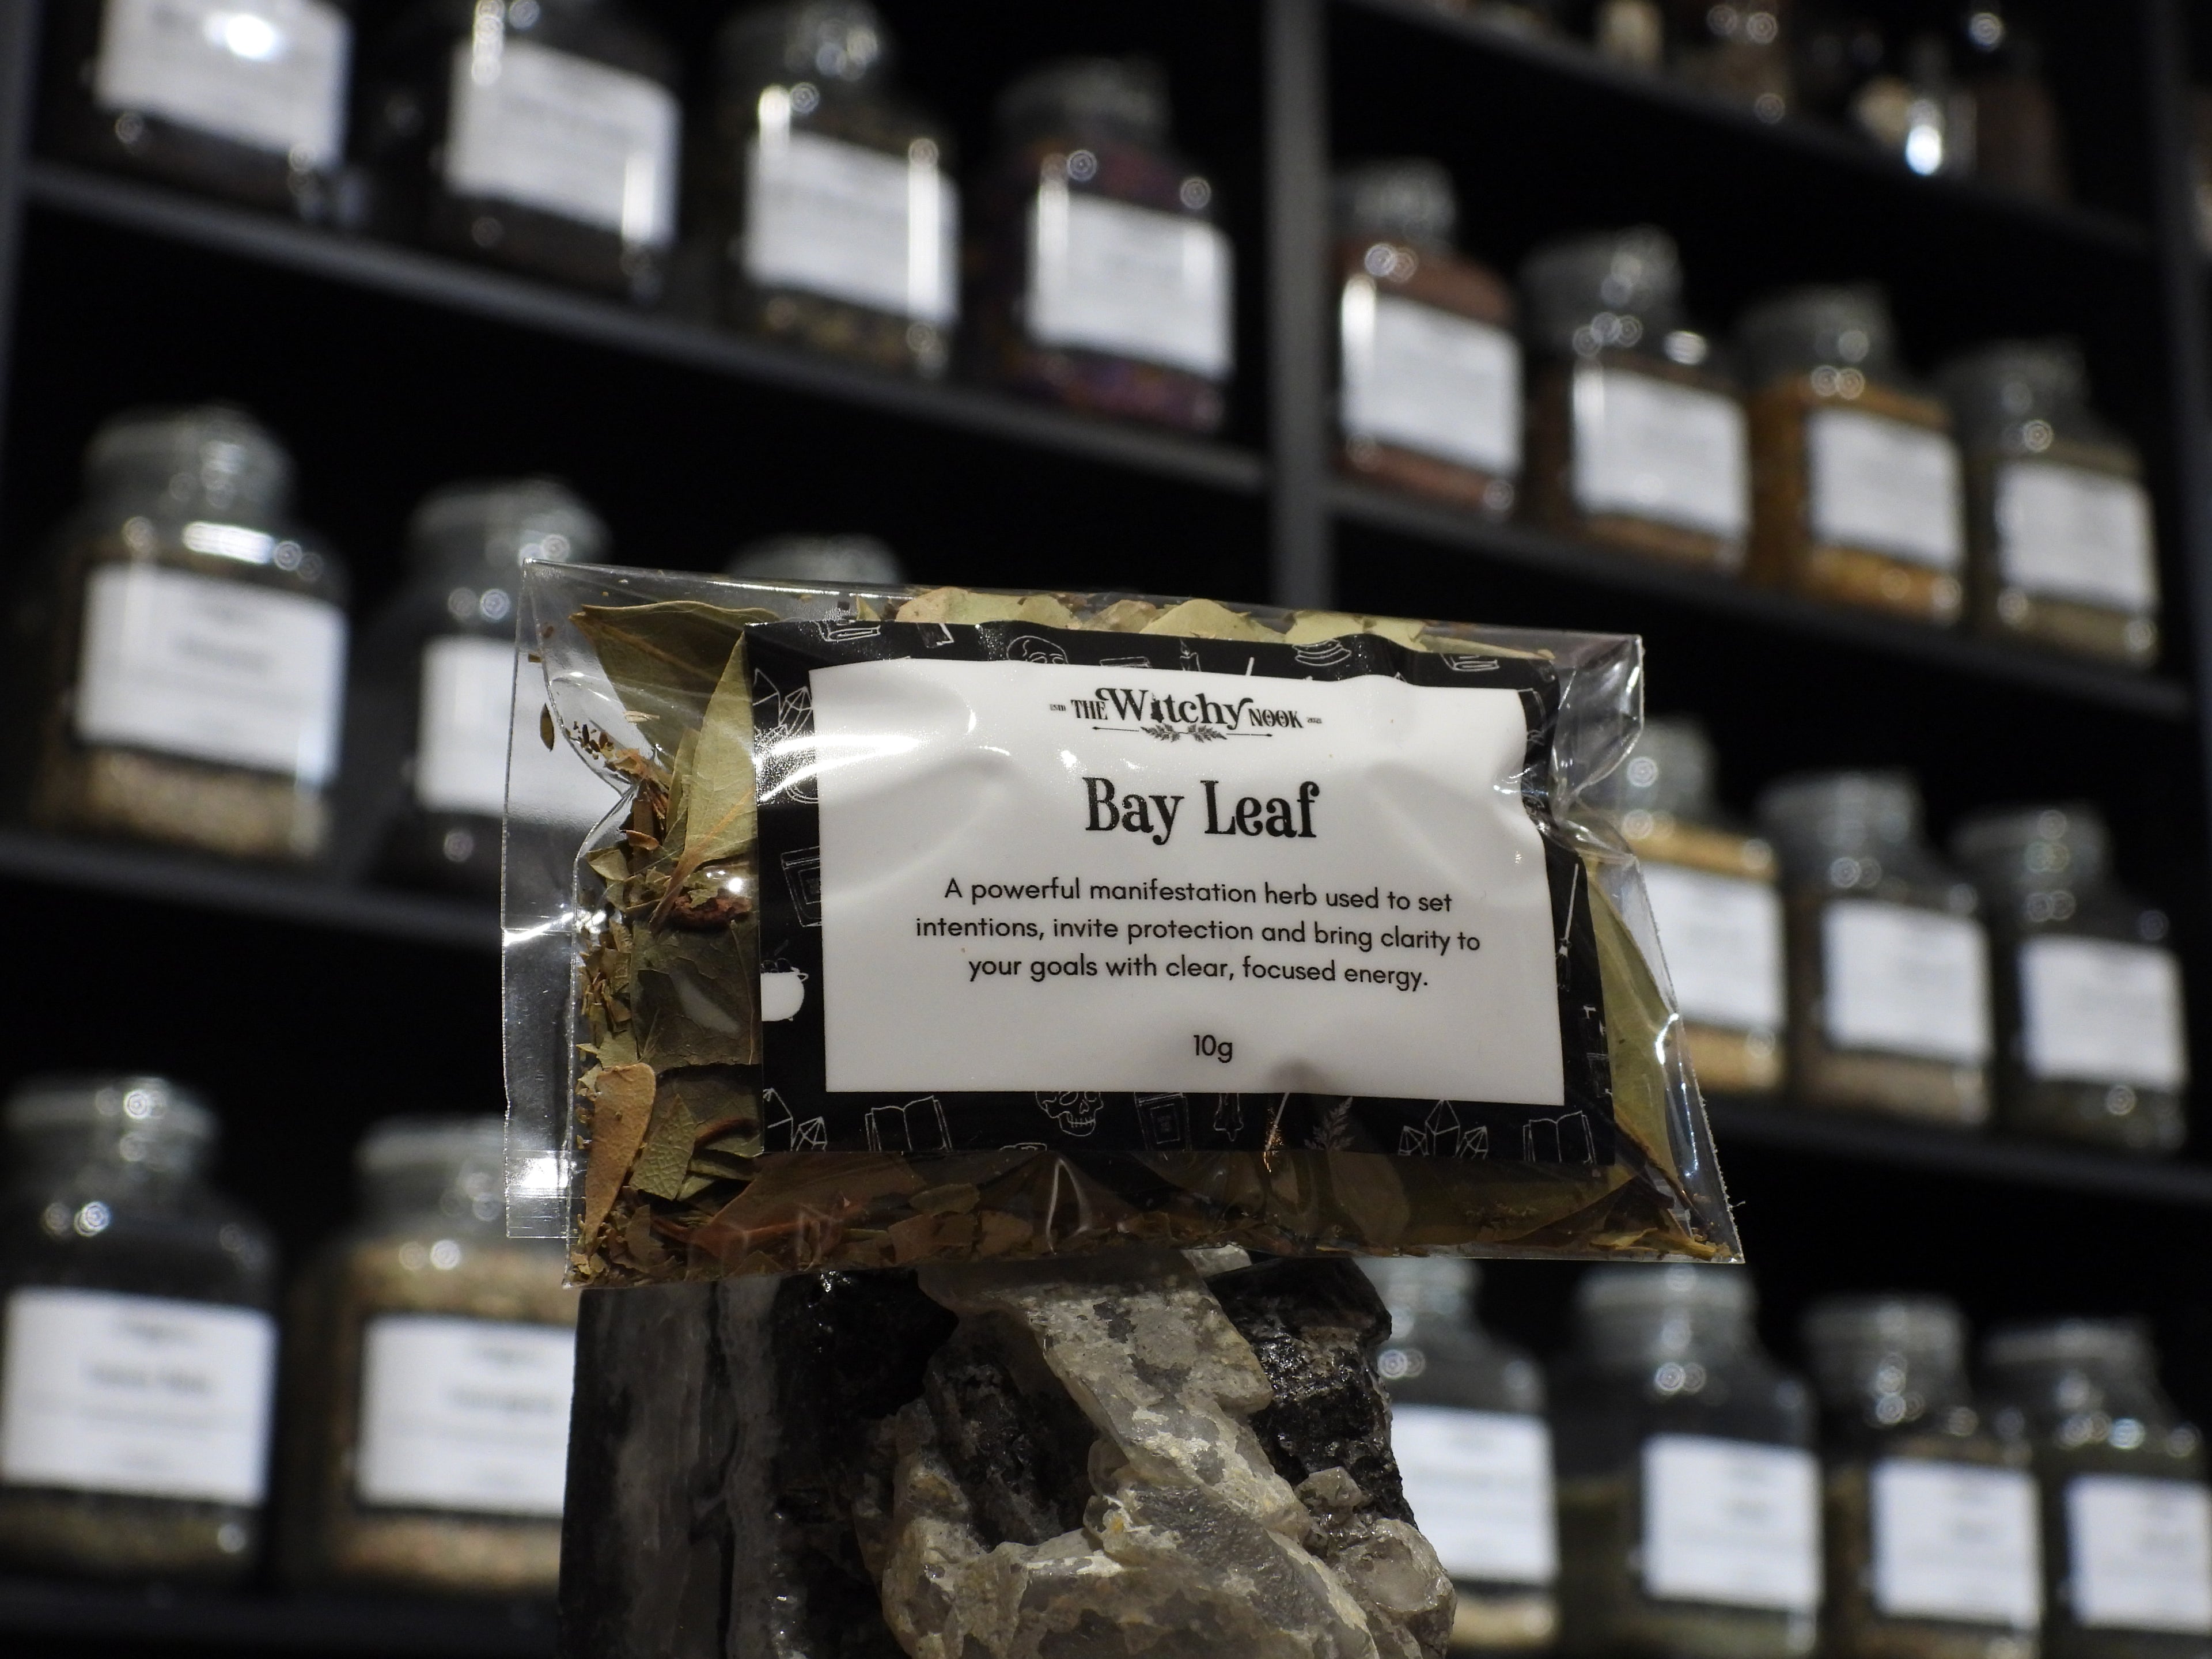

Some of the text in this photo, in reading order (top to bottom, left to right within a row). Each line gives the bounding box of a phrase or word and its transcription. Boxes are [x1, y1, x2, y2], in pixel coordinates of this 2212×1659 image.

[1070, 699, 1108, 720] THE
[1095, 687, 1253, 730] Witchy
[1248, 708, 1304, 728] NOOK
[1082, 777, 1320, 846] Bay Leaf
[944, 876, 1453, 912] A powerful manifestation herb used to set
[916, 917, 1480, 957] intentions, invite protection and bring clarity to
[968, 952, 1428, 993] your goals with clear, focused energy.
[1193, 1034, 1233, 1064] 10g
